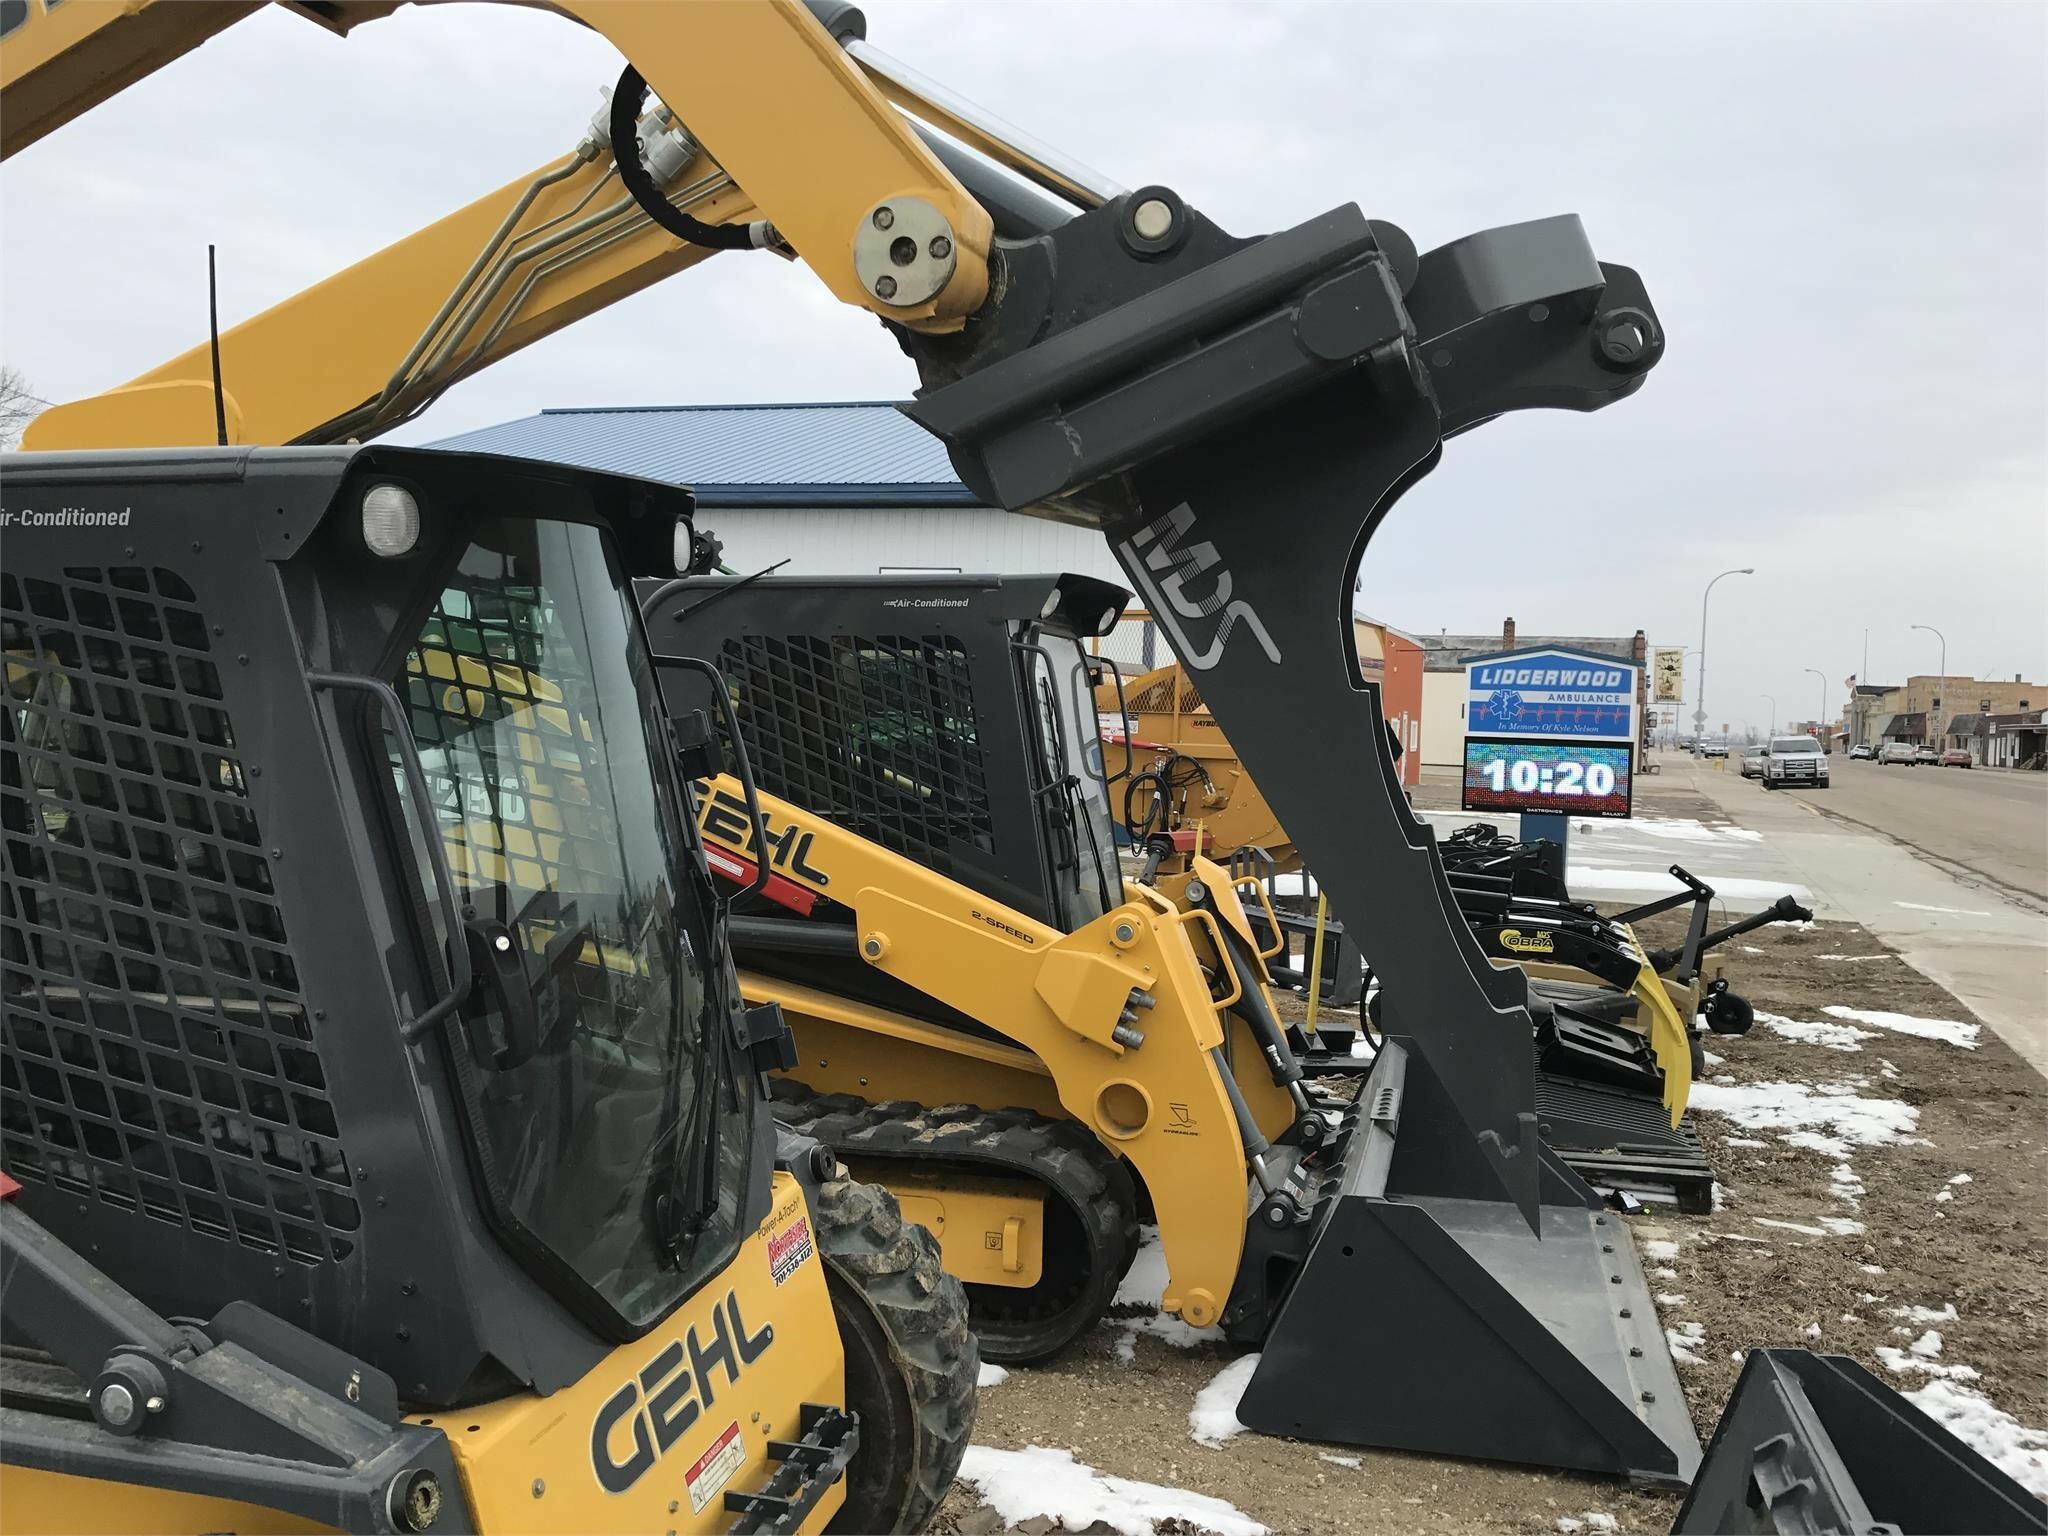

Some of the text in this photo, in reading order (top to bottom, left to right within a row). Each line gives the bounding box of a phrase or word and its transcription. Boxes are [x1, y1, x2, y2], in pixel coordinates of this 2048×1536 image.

[897, 598, 968, 607] Air-Conditioned
[1480, 668, 1622, 688] LIDGERWOOD
[1548, 693, 1620, 703] AMBULANCE
[1498, 722, 1599, 733] In Memory Of Kyle Nelson
[1484, 758, 1616, 797] 10:20
[971, 910, 1034, 944] 2-SPEED
[590, 1287, 774, 1493] GEHL
